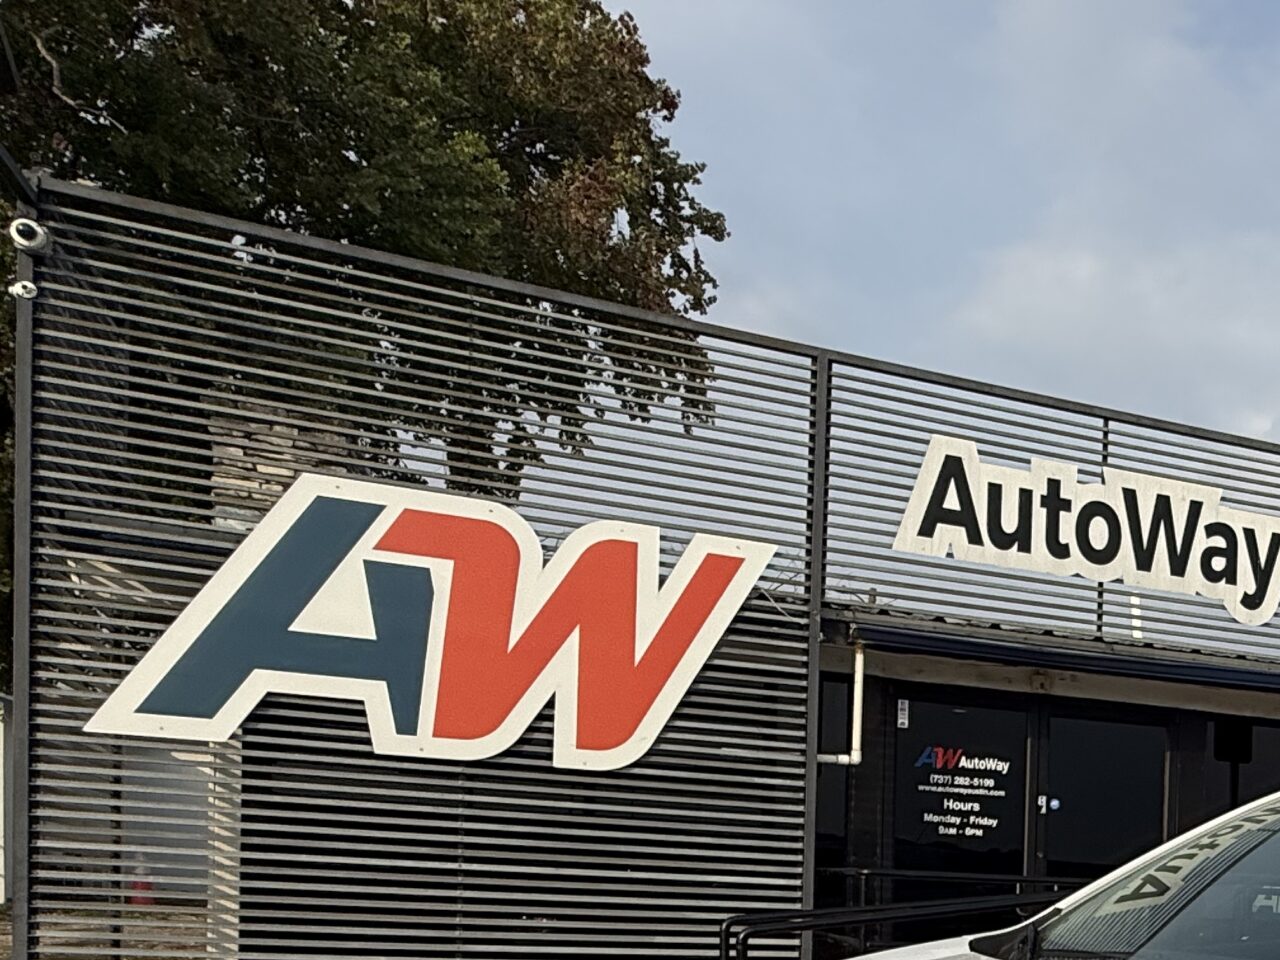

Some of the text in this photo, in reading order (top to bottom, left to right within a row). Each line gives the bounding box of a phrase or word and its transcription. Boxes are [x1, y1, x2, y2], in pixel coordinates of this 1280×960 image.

[134, 495, 746, 751] AW
[914, 746, 1010, 775] AW AutoWay
[930, 774, 952, 785] (737)
[944, 798, 980, 812] Hours
[924, 813, 961, 825] Monday
[969, 816, 998, 828] Friday
